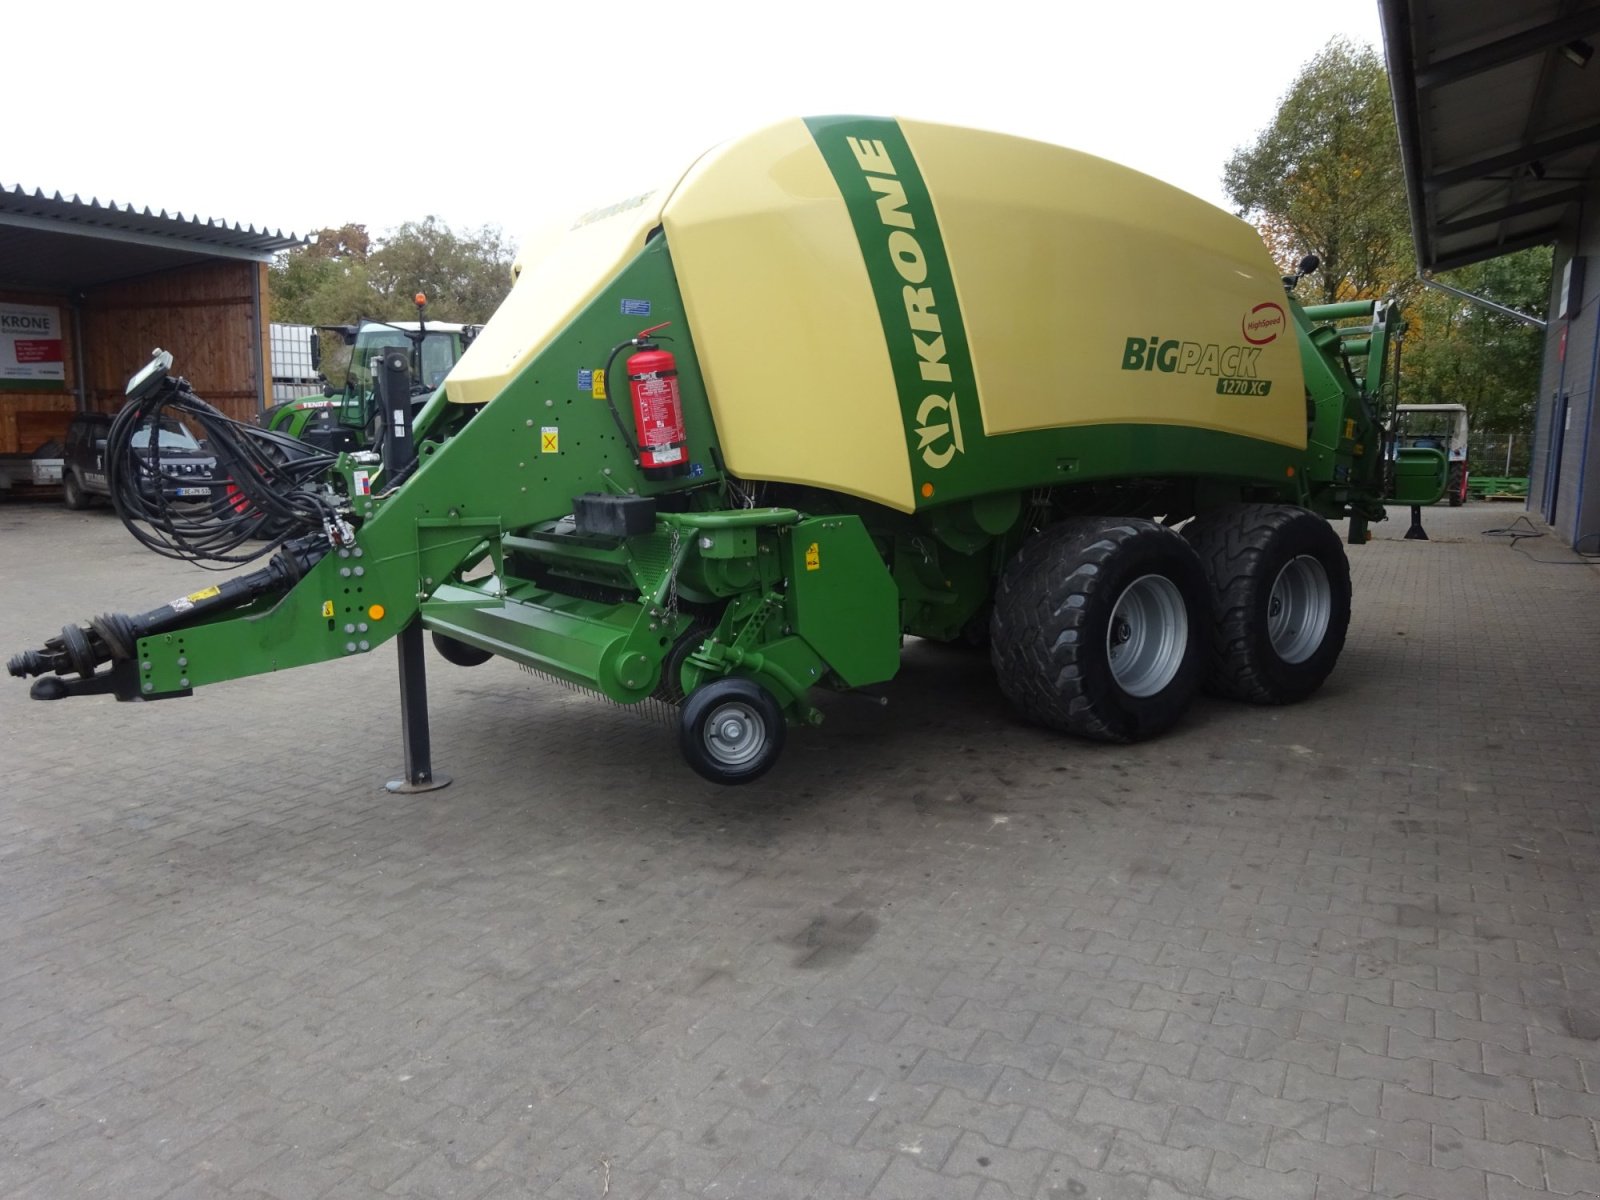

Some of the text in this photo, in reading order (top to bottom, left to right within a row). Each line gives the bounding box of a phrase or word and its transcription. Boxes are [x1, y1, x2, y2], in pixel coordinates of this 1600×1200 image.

[846, 136, 953, 383] KRONE
[1, 315, 51, 330] KRONE
[1247, 316, 1281, 331] HighSpeed
[1222, 380, 1266, 395] 1270 XC
